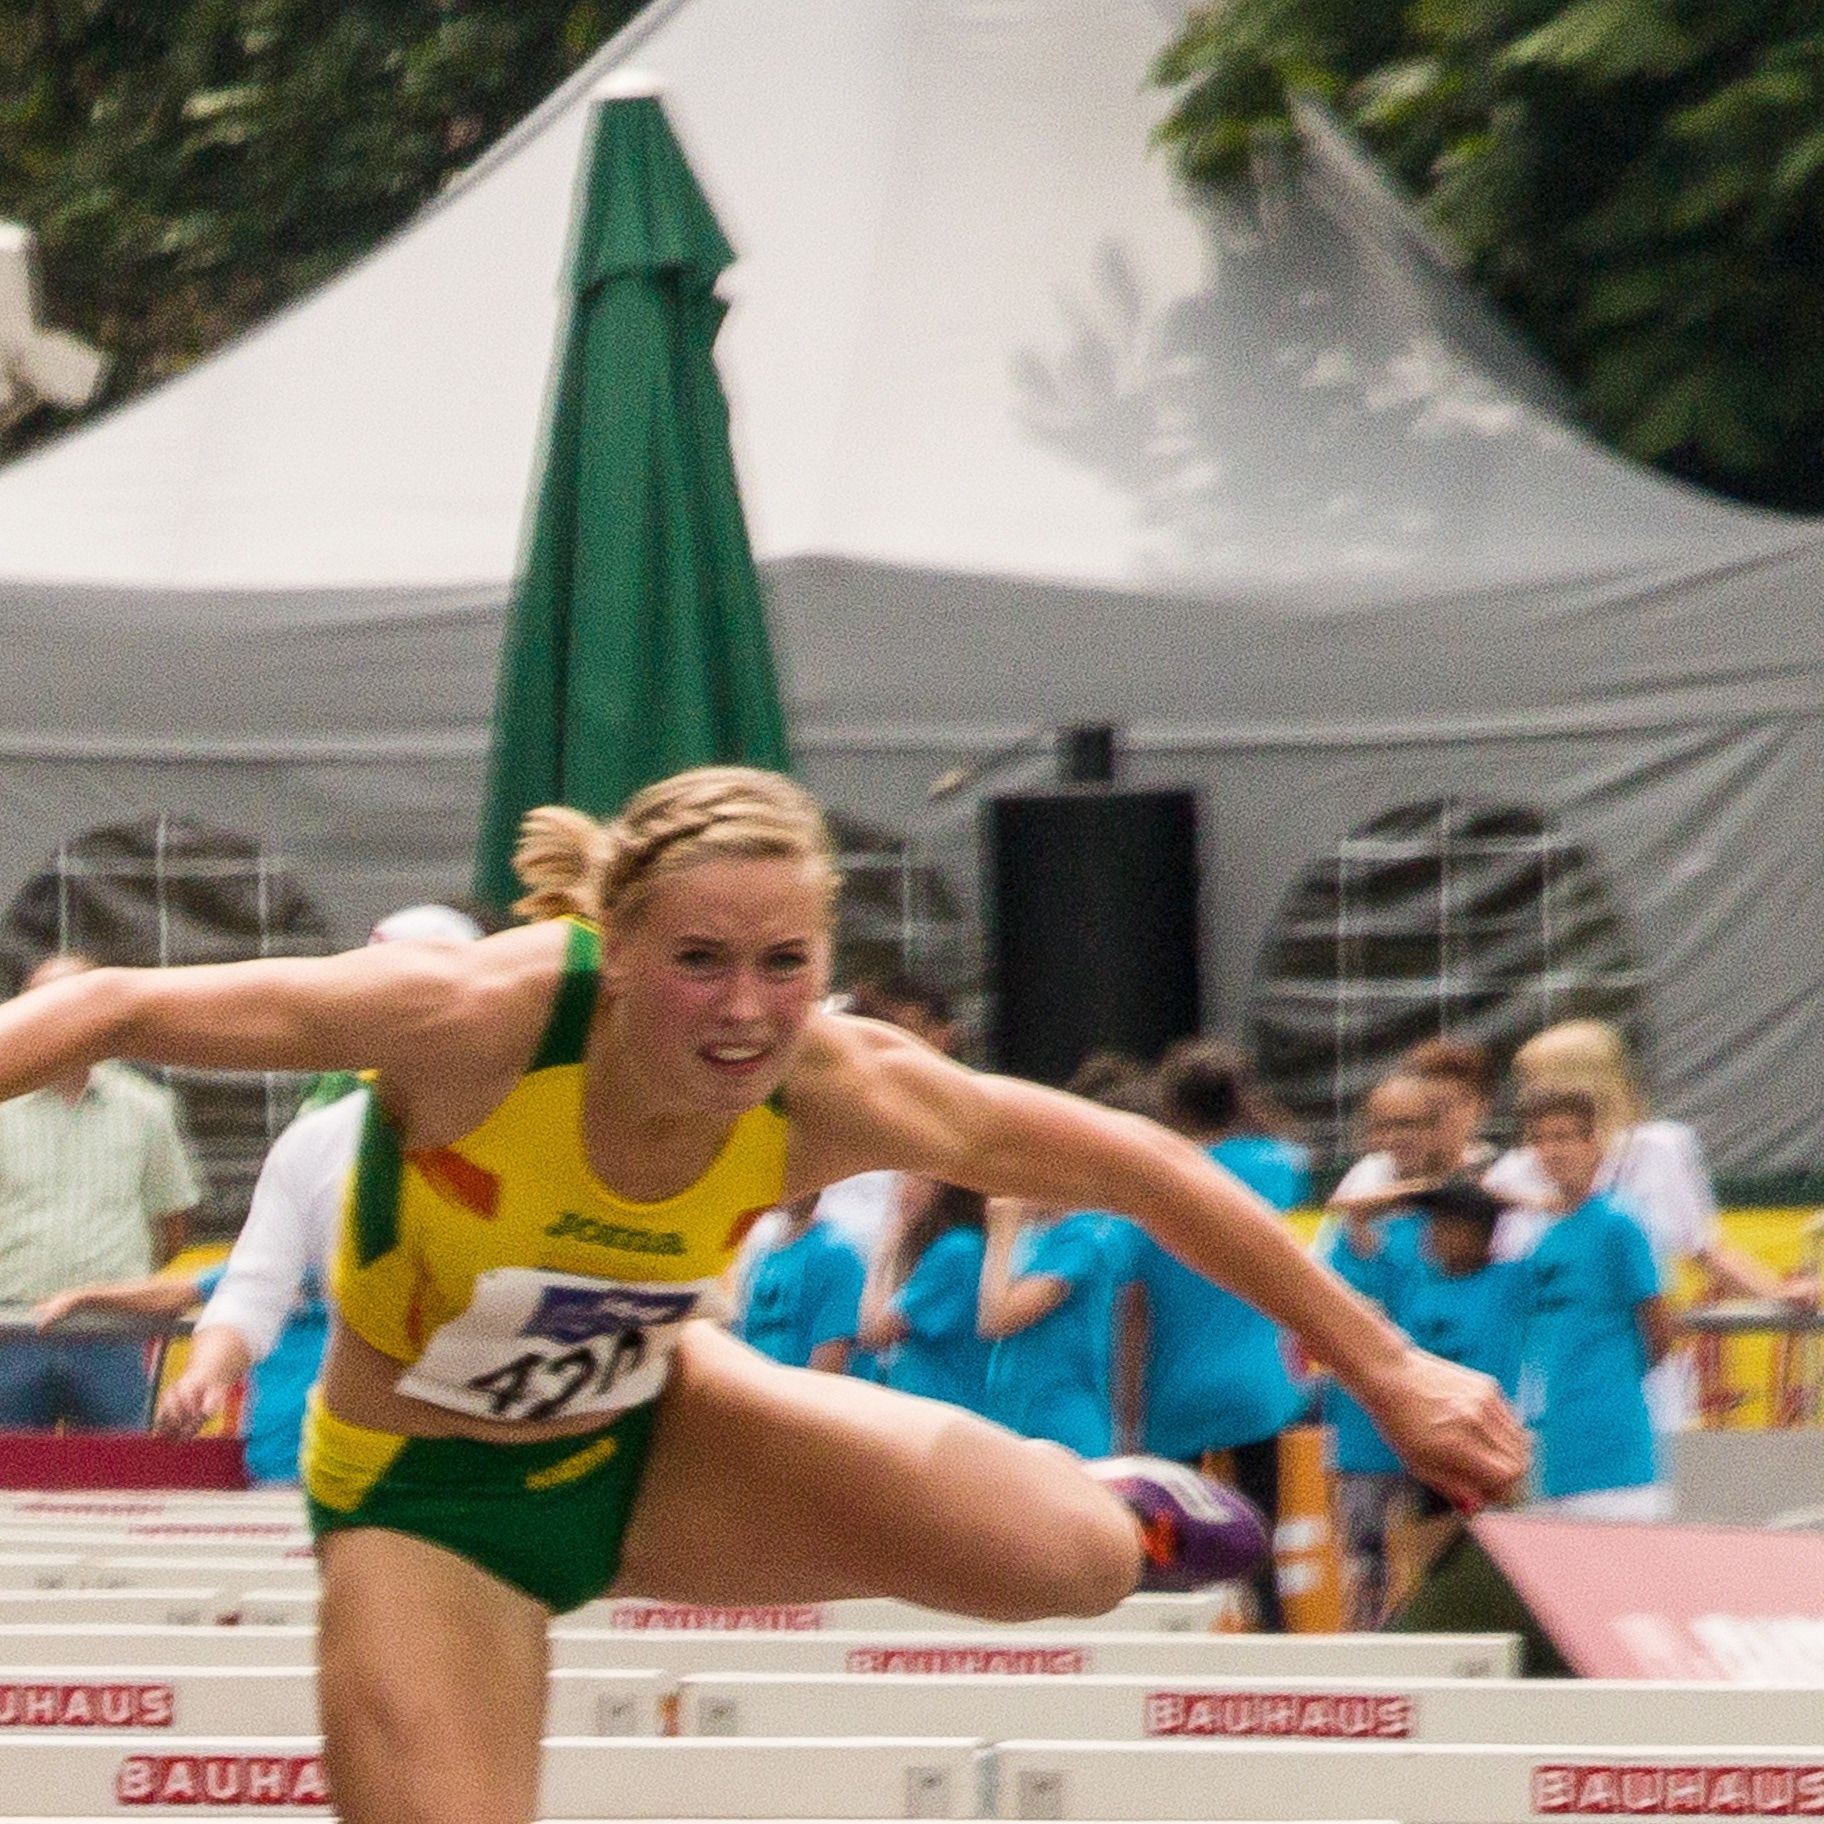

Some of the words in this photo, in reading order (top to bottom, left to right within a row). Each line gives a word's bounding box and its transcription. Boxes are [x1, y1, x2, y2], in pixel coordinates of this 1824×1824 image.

[1149, 1695, 1412, 1736] BAUHAUS
[118, 1759, 326, 1799] BAUHA
[1534, 1769, 1824, 1811] BAUHAUS
